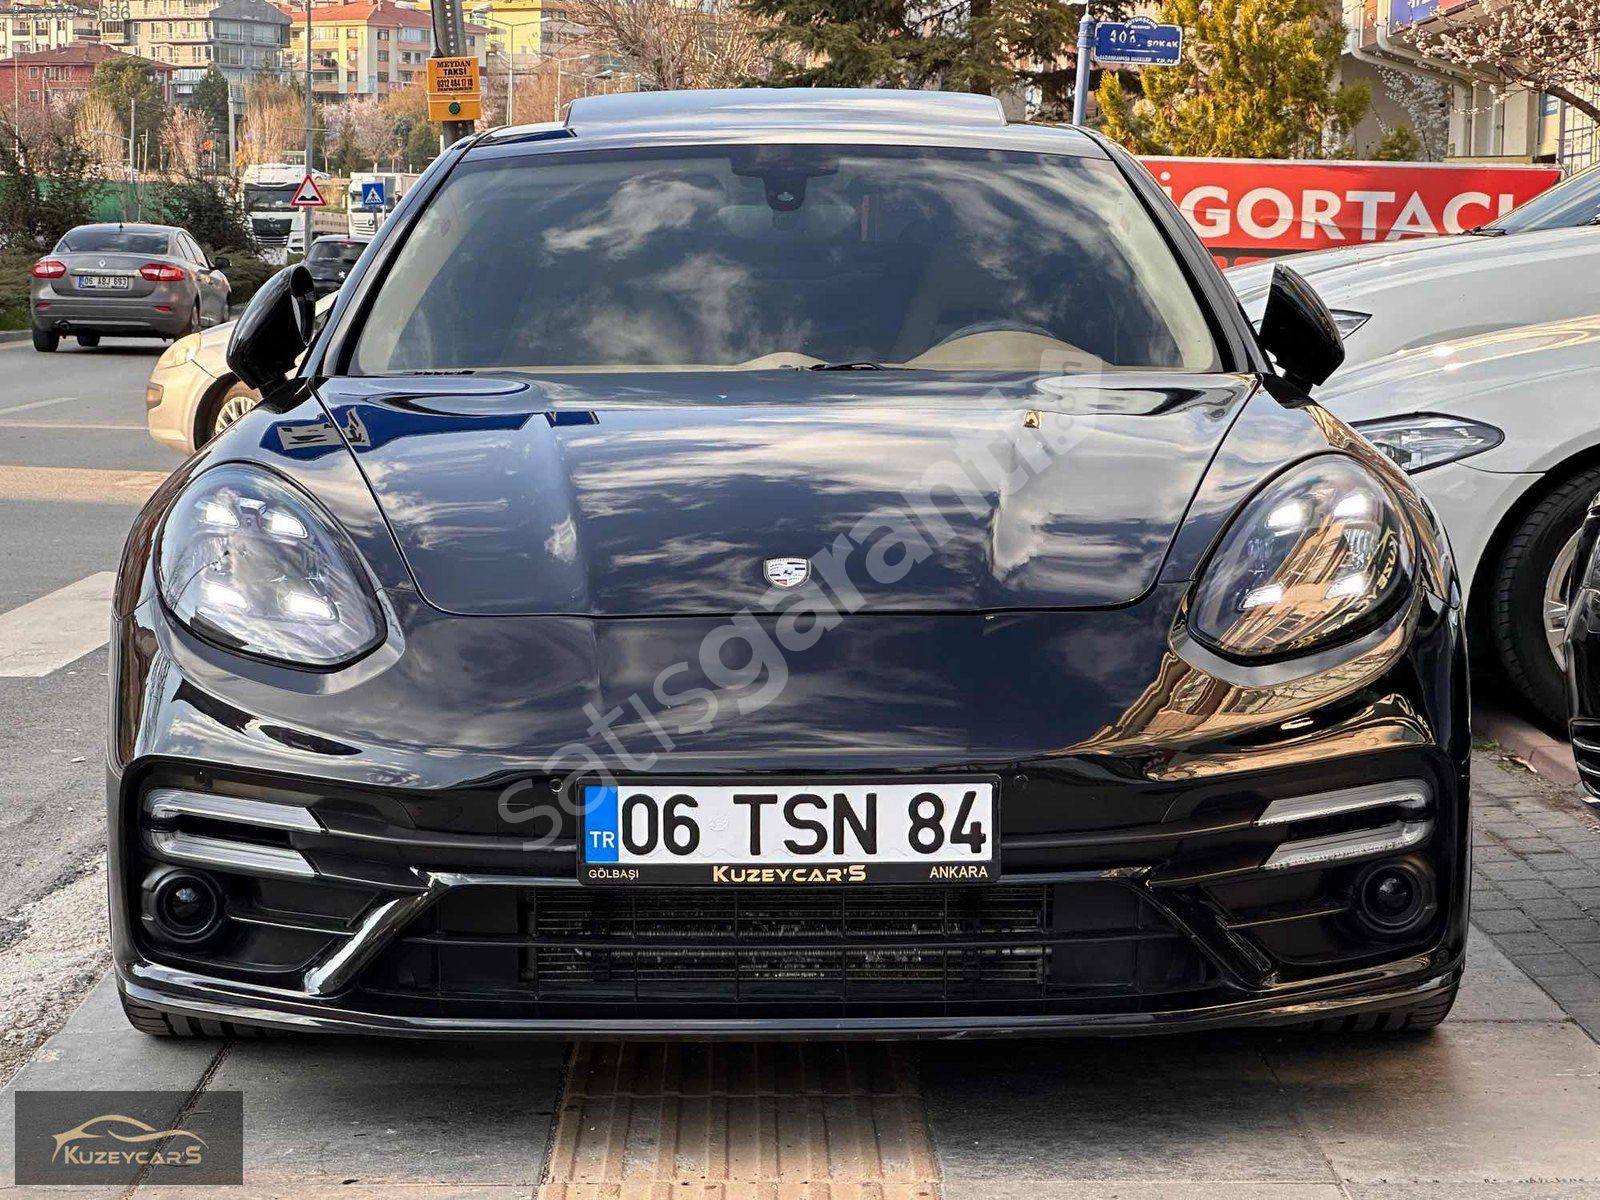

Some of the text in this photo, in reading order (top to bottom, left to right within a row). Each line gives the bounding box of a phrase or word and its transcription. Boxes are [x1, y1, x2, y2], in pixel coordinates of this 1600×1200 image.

[589, 790, 987, 856] TR 06 TSN 84
[588, 868, 639, 880] GÖLBAŞI
[929, 865, 988, 879] ANKARA
